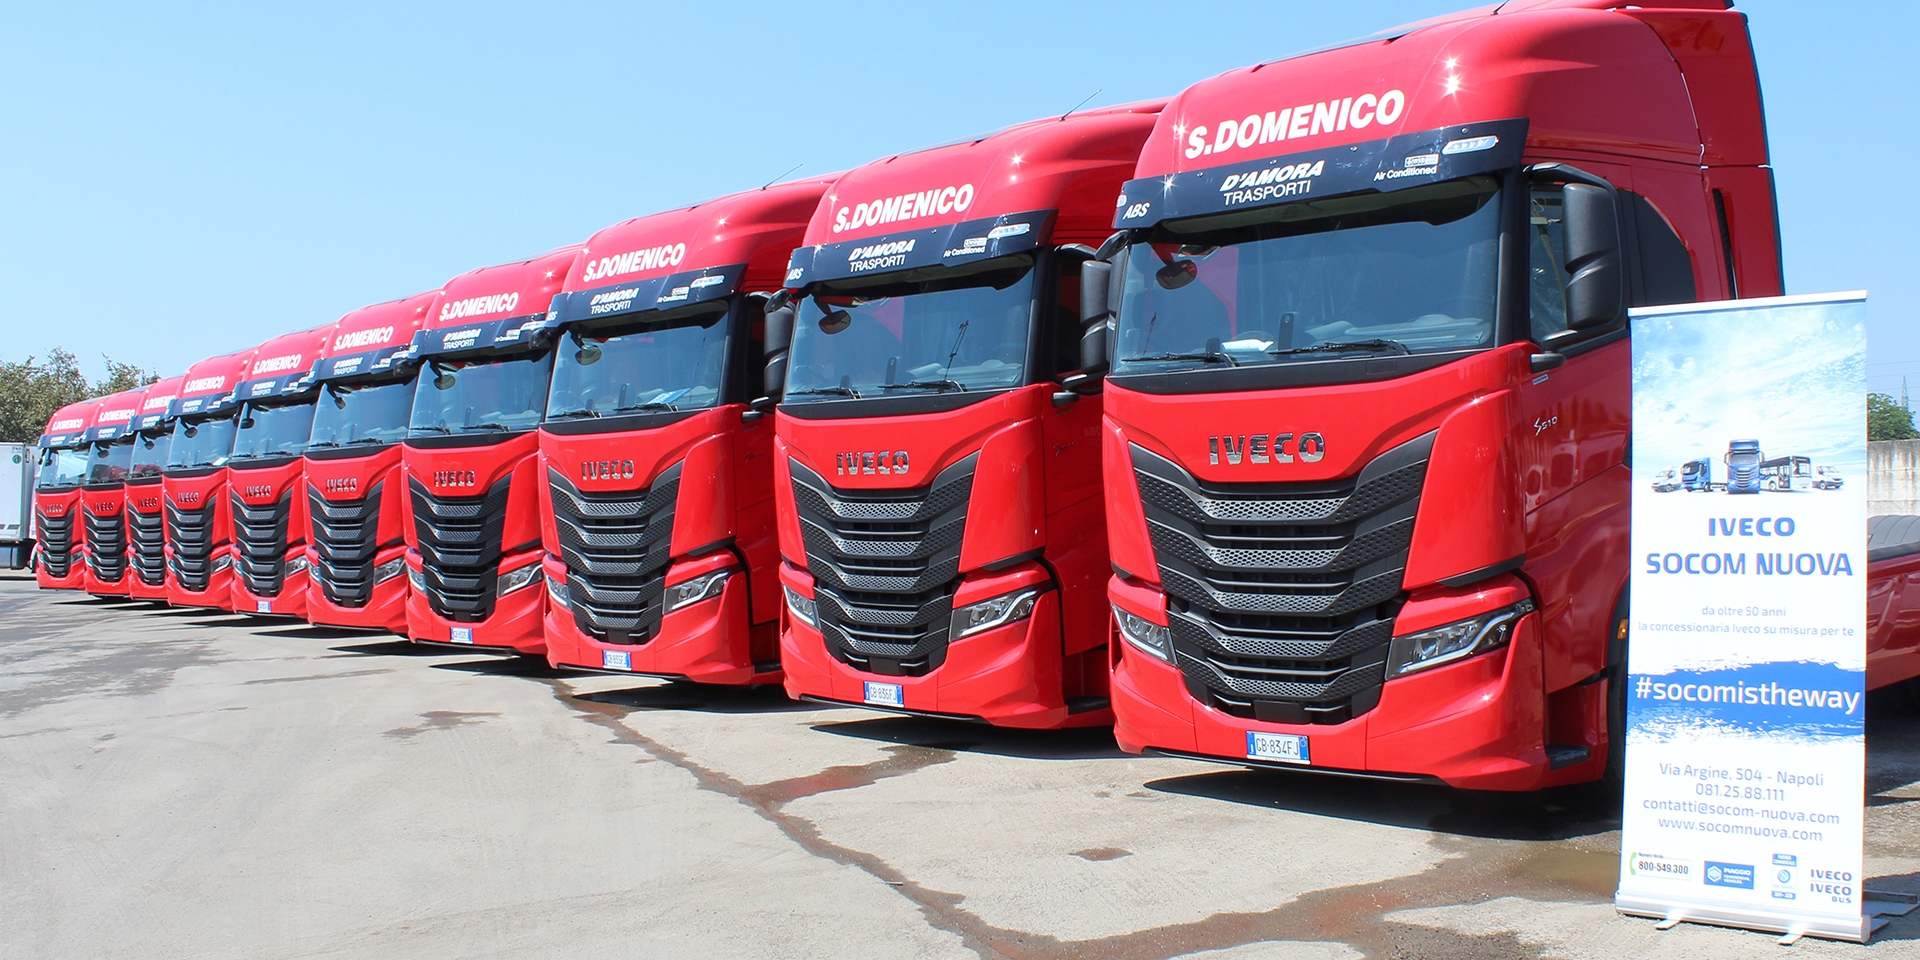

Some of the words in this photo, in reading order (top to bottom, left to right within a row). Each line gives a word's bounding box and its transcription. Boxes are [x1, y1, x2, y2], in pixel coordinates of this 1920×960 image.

[1184, 89, 1405, 159] S.DOMENICO
[1219, 160, 1325, 193] D'AMORA
[1373, 172, 1386, 181] Air
[1387, 165, 1438, 180] Conditioned
[1223, 180, 1311, 207] TRASPORTI
[833, 183, 974, 233] S.DOMENICO
[1122, 202, 1151, 220] ABS
[848, 239, 916, 261] D'AMORA
[952, 246, 986, 257] Conditioned
[583, 242, 686, 282] S.DOMENICO
[850, 254, 905, 272] TRASPORTI
[786, 267, 805, 281] ABS
[590, 287, 640, 306] D'AMORA
[439, 292, 519, 322] S.DOMENICO
[590, 299, 631, 315] TRASPORTI
[333, 326, 394, 352] S.DOMENICO
[443, 338, 475, 350] TRASPORTI
[252, 353, 302, 375] S.DOMENICO
[183, 375, 225, 393] S.DOMENICO
[51, 418, 83, 431] S.DOMENICO
[1209, 432, 1325, 465] IVECO
[581, 459, 635, 481] IVECO
[837, 450, 910, 476] IVECO
[325, 478, 357, 492] IVECO
[434, 470, 475, 487] IVECO
[177, 492, 199, 503] IVECO
[245, 485, 272, 498] IVECO
[94, 502, 114, 511] IVECO
[138, 497, 158, 507] IVECO
[1708, 517, 1795, 537] IVECO
[1646, 552, 1746, 575] SOCOM
[1755, 552, 1853, 576] NUOVA
[1701, 605, 1715, 616] da
[1717, 606, 1743, 616] oltre
[1745, 606, 1759, 616] 50
[1761, 606, 1787, 617] anni
[1638, 621, 1647, 631] la
[1649, 621, 1730, 633] concessionaria
[1732, 623, 1760, 634] Iveco
[1763, 626, 1776, 635] su
[1779, 624, 1818, 636] misura
[1820, 627, 1839, 638] per
[1842, 627, 1854, 637] te
[1635, 676, 1860, 715] #socomistheway
[1659, 762, 1681, 776] Via
[1683, 764, 1732, 781] Argine,
[1736, 768, 1762, 782] 504
[1776, 771, 1824, 787] Napoli
[1695, 783, 1785, 802] 081.25.88.111
[1643, 798, 1840, 824] contatti@socom-nuova.com
[1658, 817, 1823, 842] www.socomnuova.com
[1638, 860, 1689, 874] 800-549.300
[1723, 867, 1752, 876] PIAGGIO
[1810, 869, 1852, 882] IVECO
[1810, 883, 1852, 896] IVECO
[1831, 896, 1852, 904] BUS
